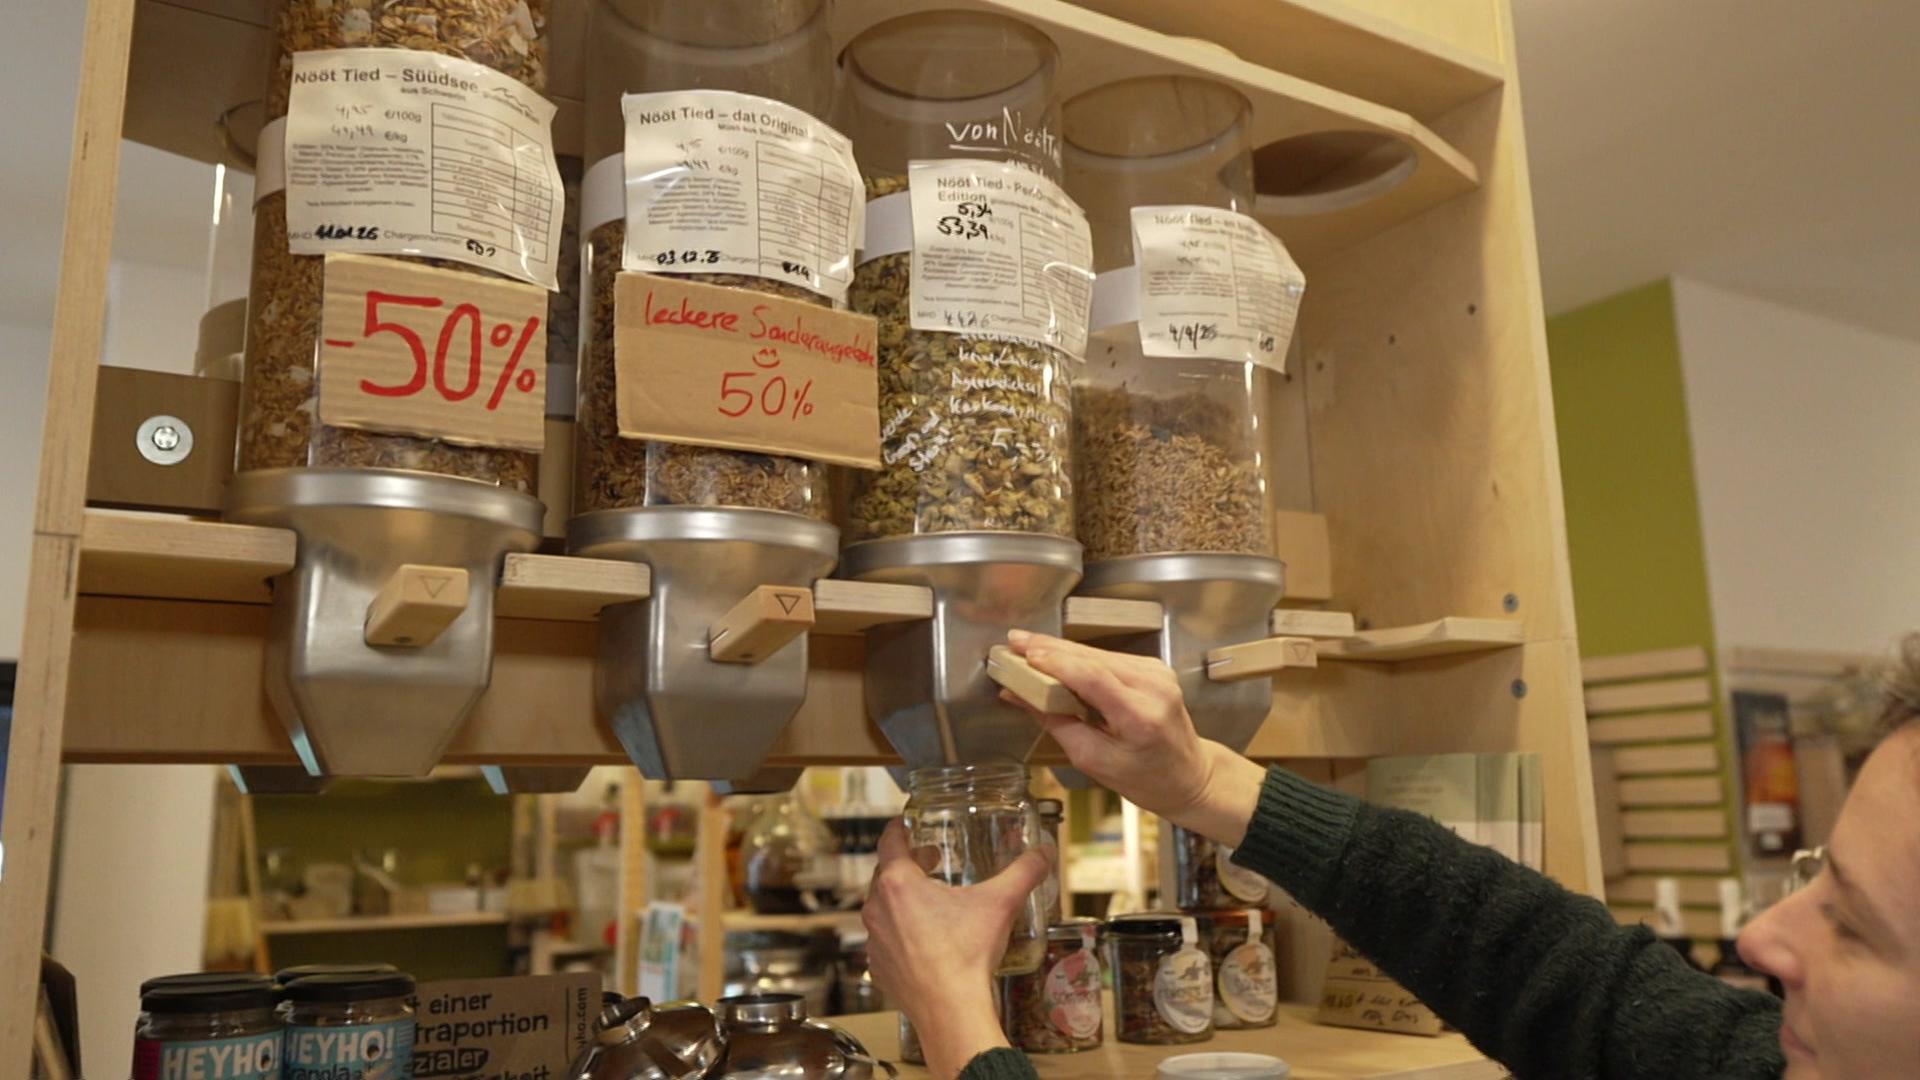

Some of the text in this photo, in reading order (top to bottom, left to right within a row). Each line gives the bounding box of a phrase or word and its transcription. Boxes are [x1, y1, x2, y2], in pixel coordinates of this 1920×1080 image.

[294, 69, 337, 84] Nööt
[341, 68, 380, 82] Tied
[401, 68, 479, 92] Süüdsee
[384, 109, 422, 124] €/100g
[640, 109, 676, 125] Nööt
[680, 106, 715, 121] Tied
[732, 109, 756, 123] dat
[945, 120, 998, 142] von
[937, 177, 971, 189] Nööt
[937, 191, 987, 204] Edition
[324, 290, 541, 411] -50%
[717, 371, 815, 421] 50%
[430, 993, 493, 1015] einer
[575, 987, 588, 1049] yho.com
[287, 1028, 396, 1064] HEYHO!
[162, 1037, 282, 1080] HEYHO!
[413, 1050, 486, 1073] zialer
